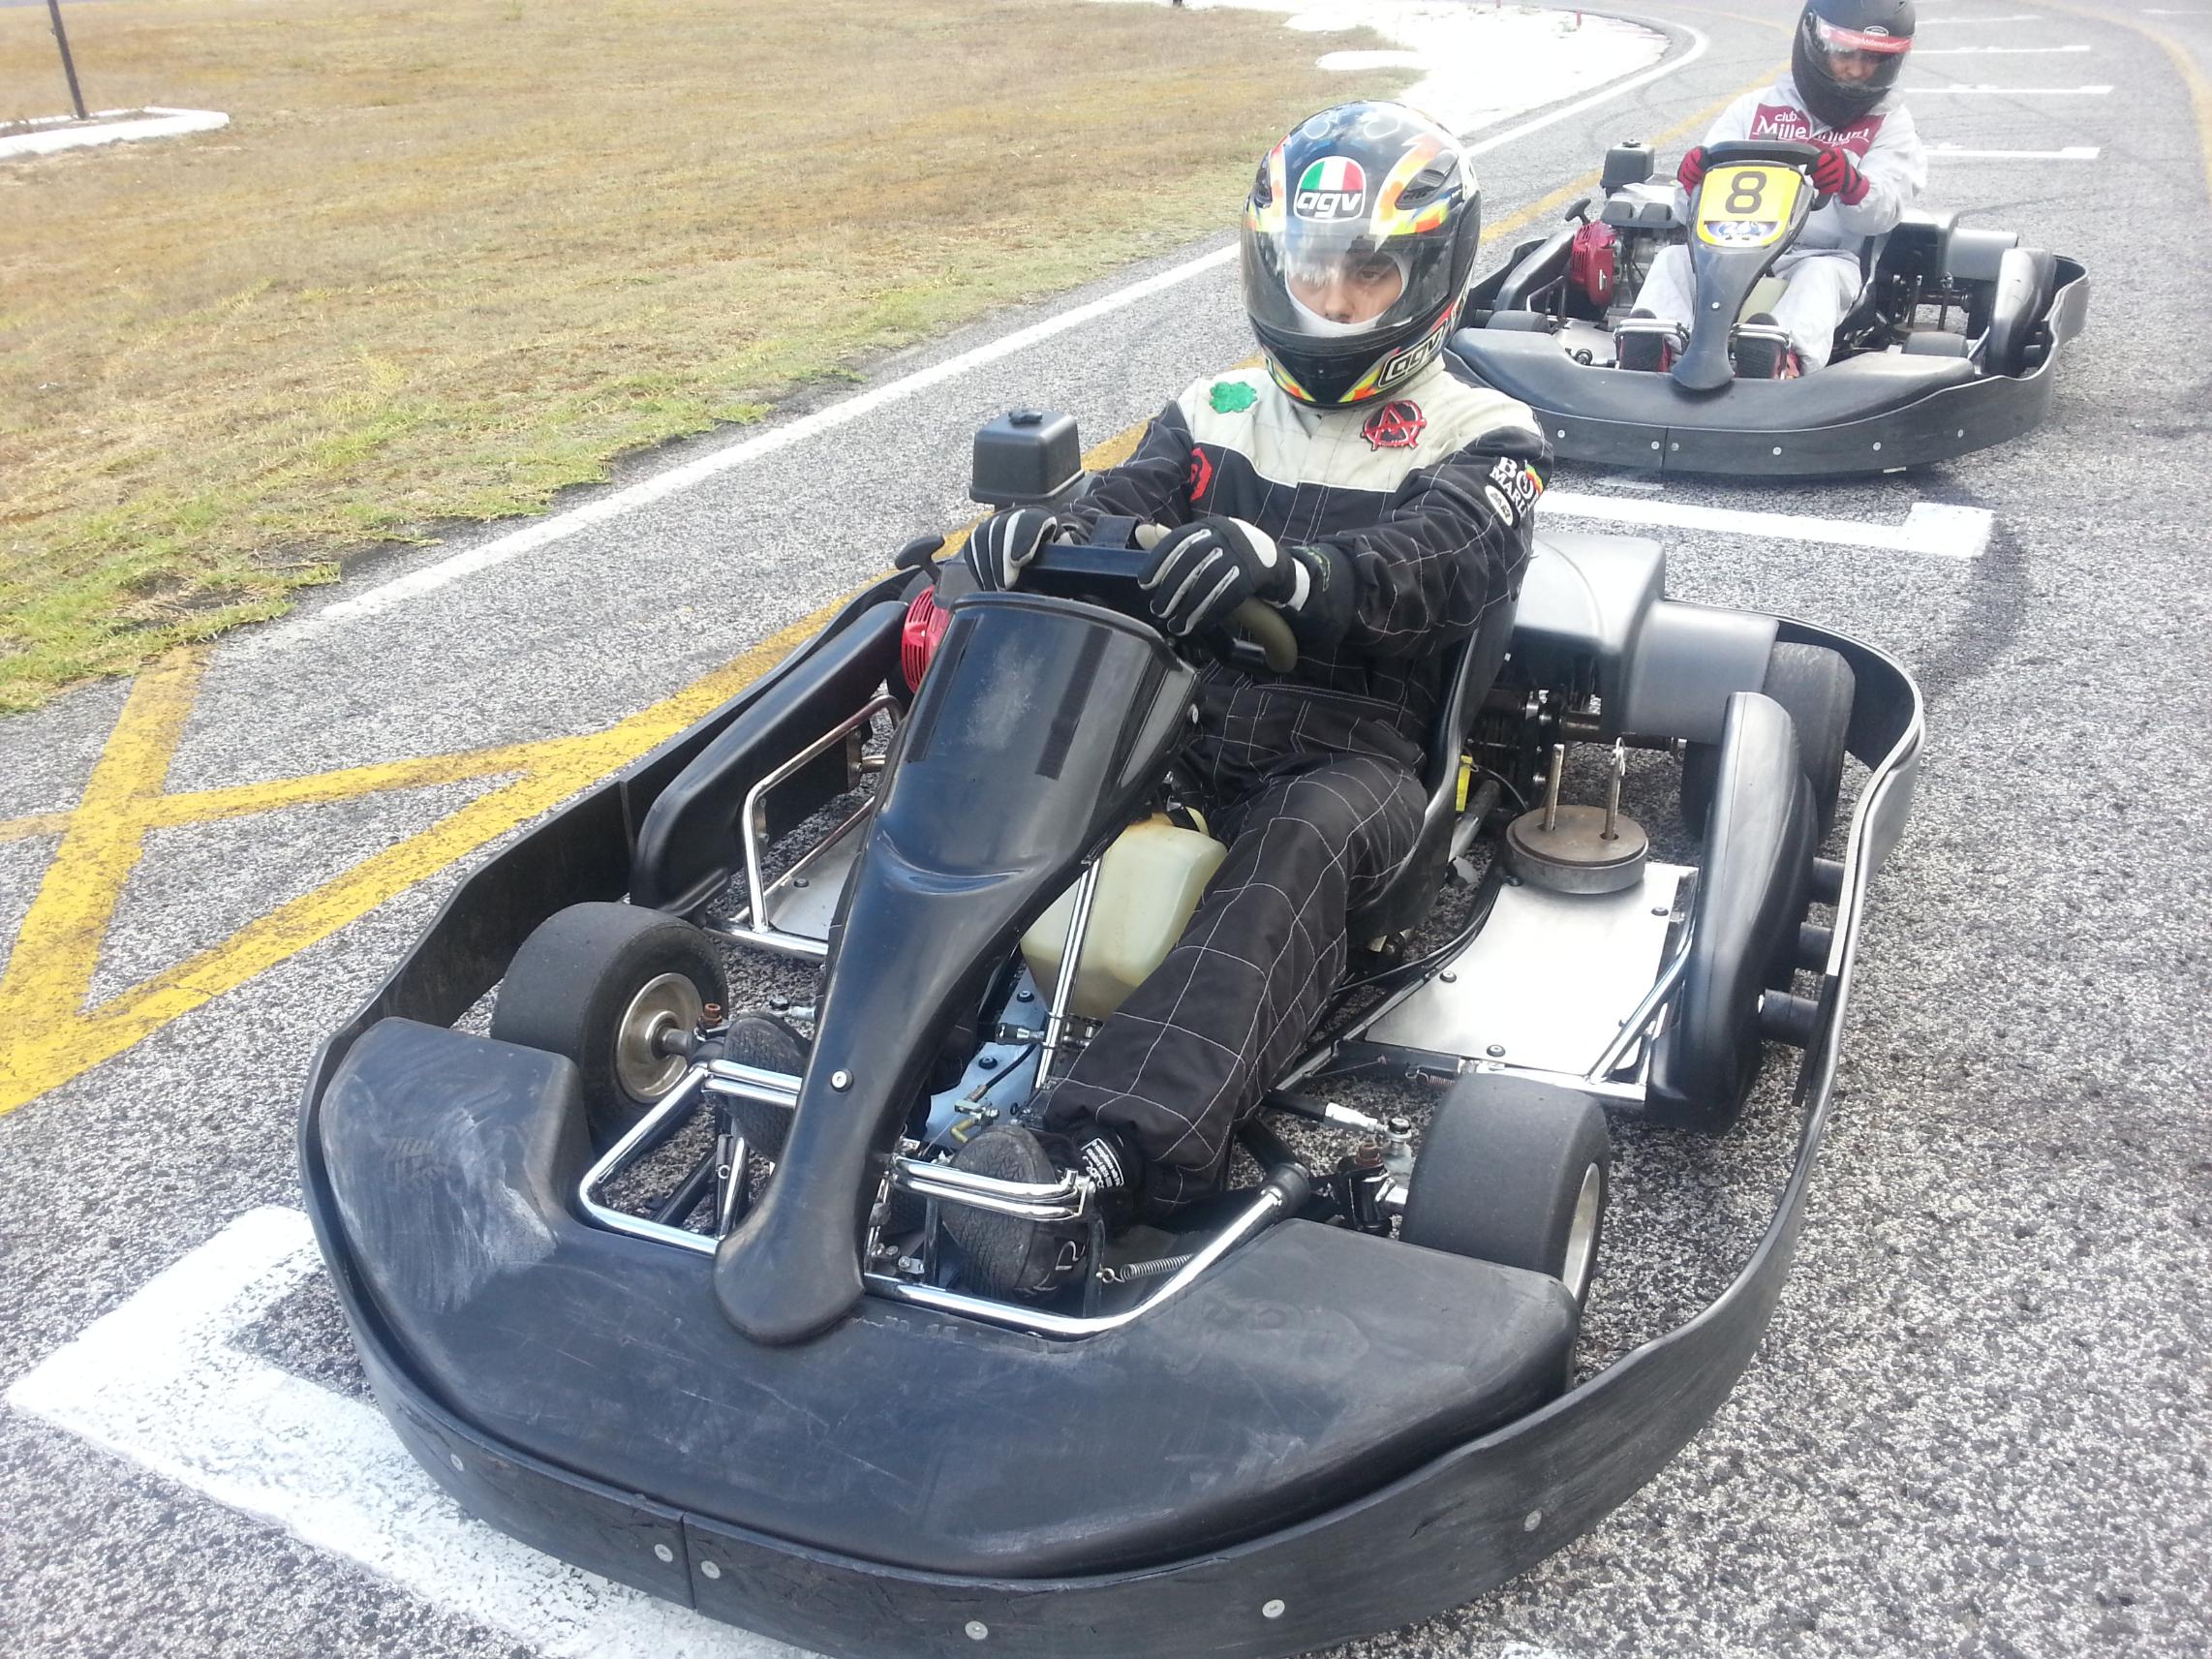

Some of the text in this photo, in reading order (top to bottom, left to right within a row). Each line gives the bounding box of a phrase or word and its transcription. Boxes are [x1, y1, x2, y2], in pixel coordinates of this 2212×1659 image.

[1774, 111, 1797, 122] club
[1297, 192, 1362, 218] agv
[1725, 170, 1767, 214] 8
[1385, 325, 1446, 382] agv
